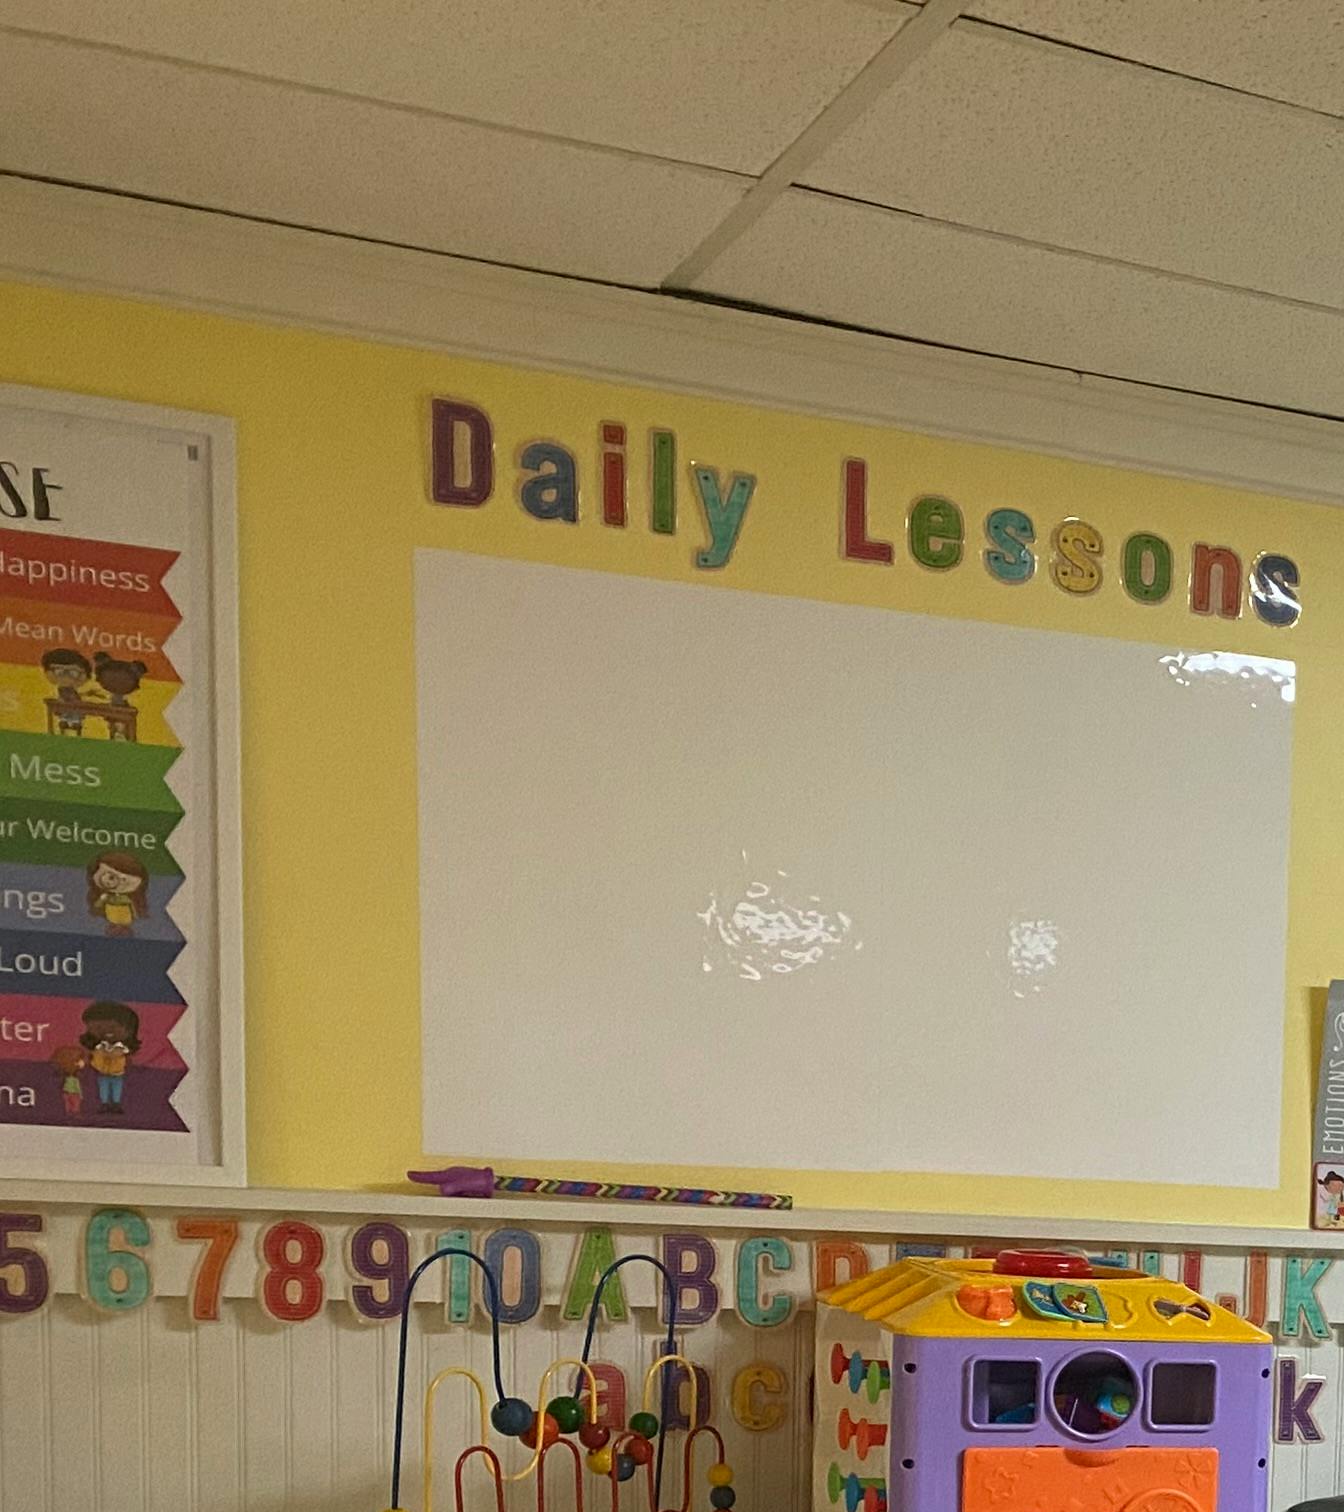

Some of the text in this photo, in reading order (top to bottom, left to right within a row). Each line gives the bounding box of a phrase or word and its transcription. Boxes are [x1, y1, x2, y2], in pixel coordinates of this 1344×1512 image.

[431, 396, 1302, 628] Daily Lessons
[0, 552, 150, 593] appiness
[71, 624, 157, 652] Words
[10, 753, 102, 787] Mess
[26, 817, 157, 850] Welcome
